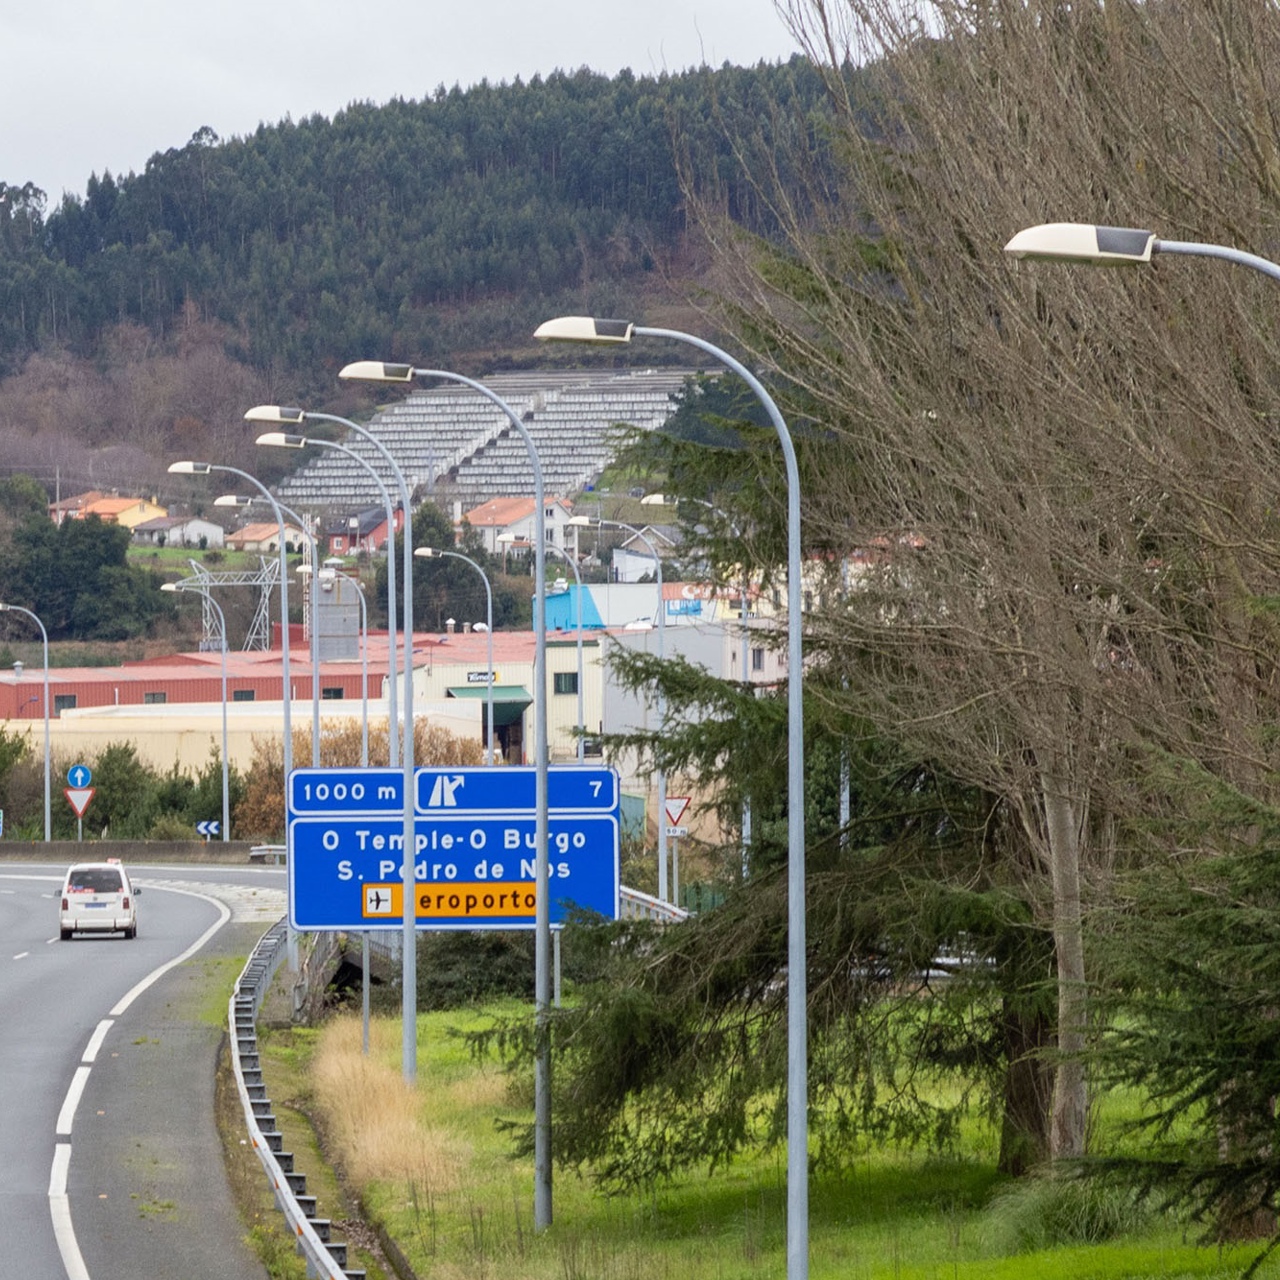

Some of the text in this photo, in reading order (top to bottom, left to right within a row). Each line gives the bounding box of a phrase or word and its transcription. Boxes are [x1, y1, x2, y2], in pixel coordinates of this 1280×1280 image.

[304, 783, 396, 800] 1000 m
[590, 781, 602, 797] 7
[322, 830, 339, 850] O
[338, 860, 363, 880] S.
[474, 860, 504, 879] de
[412, 890, 536, 914] eroporto
